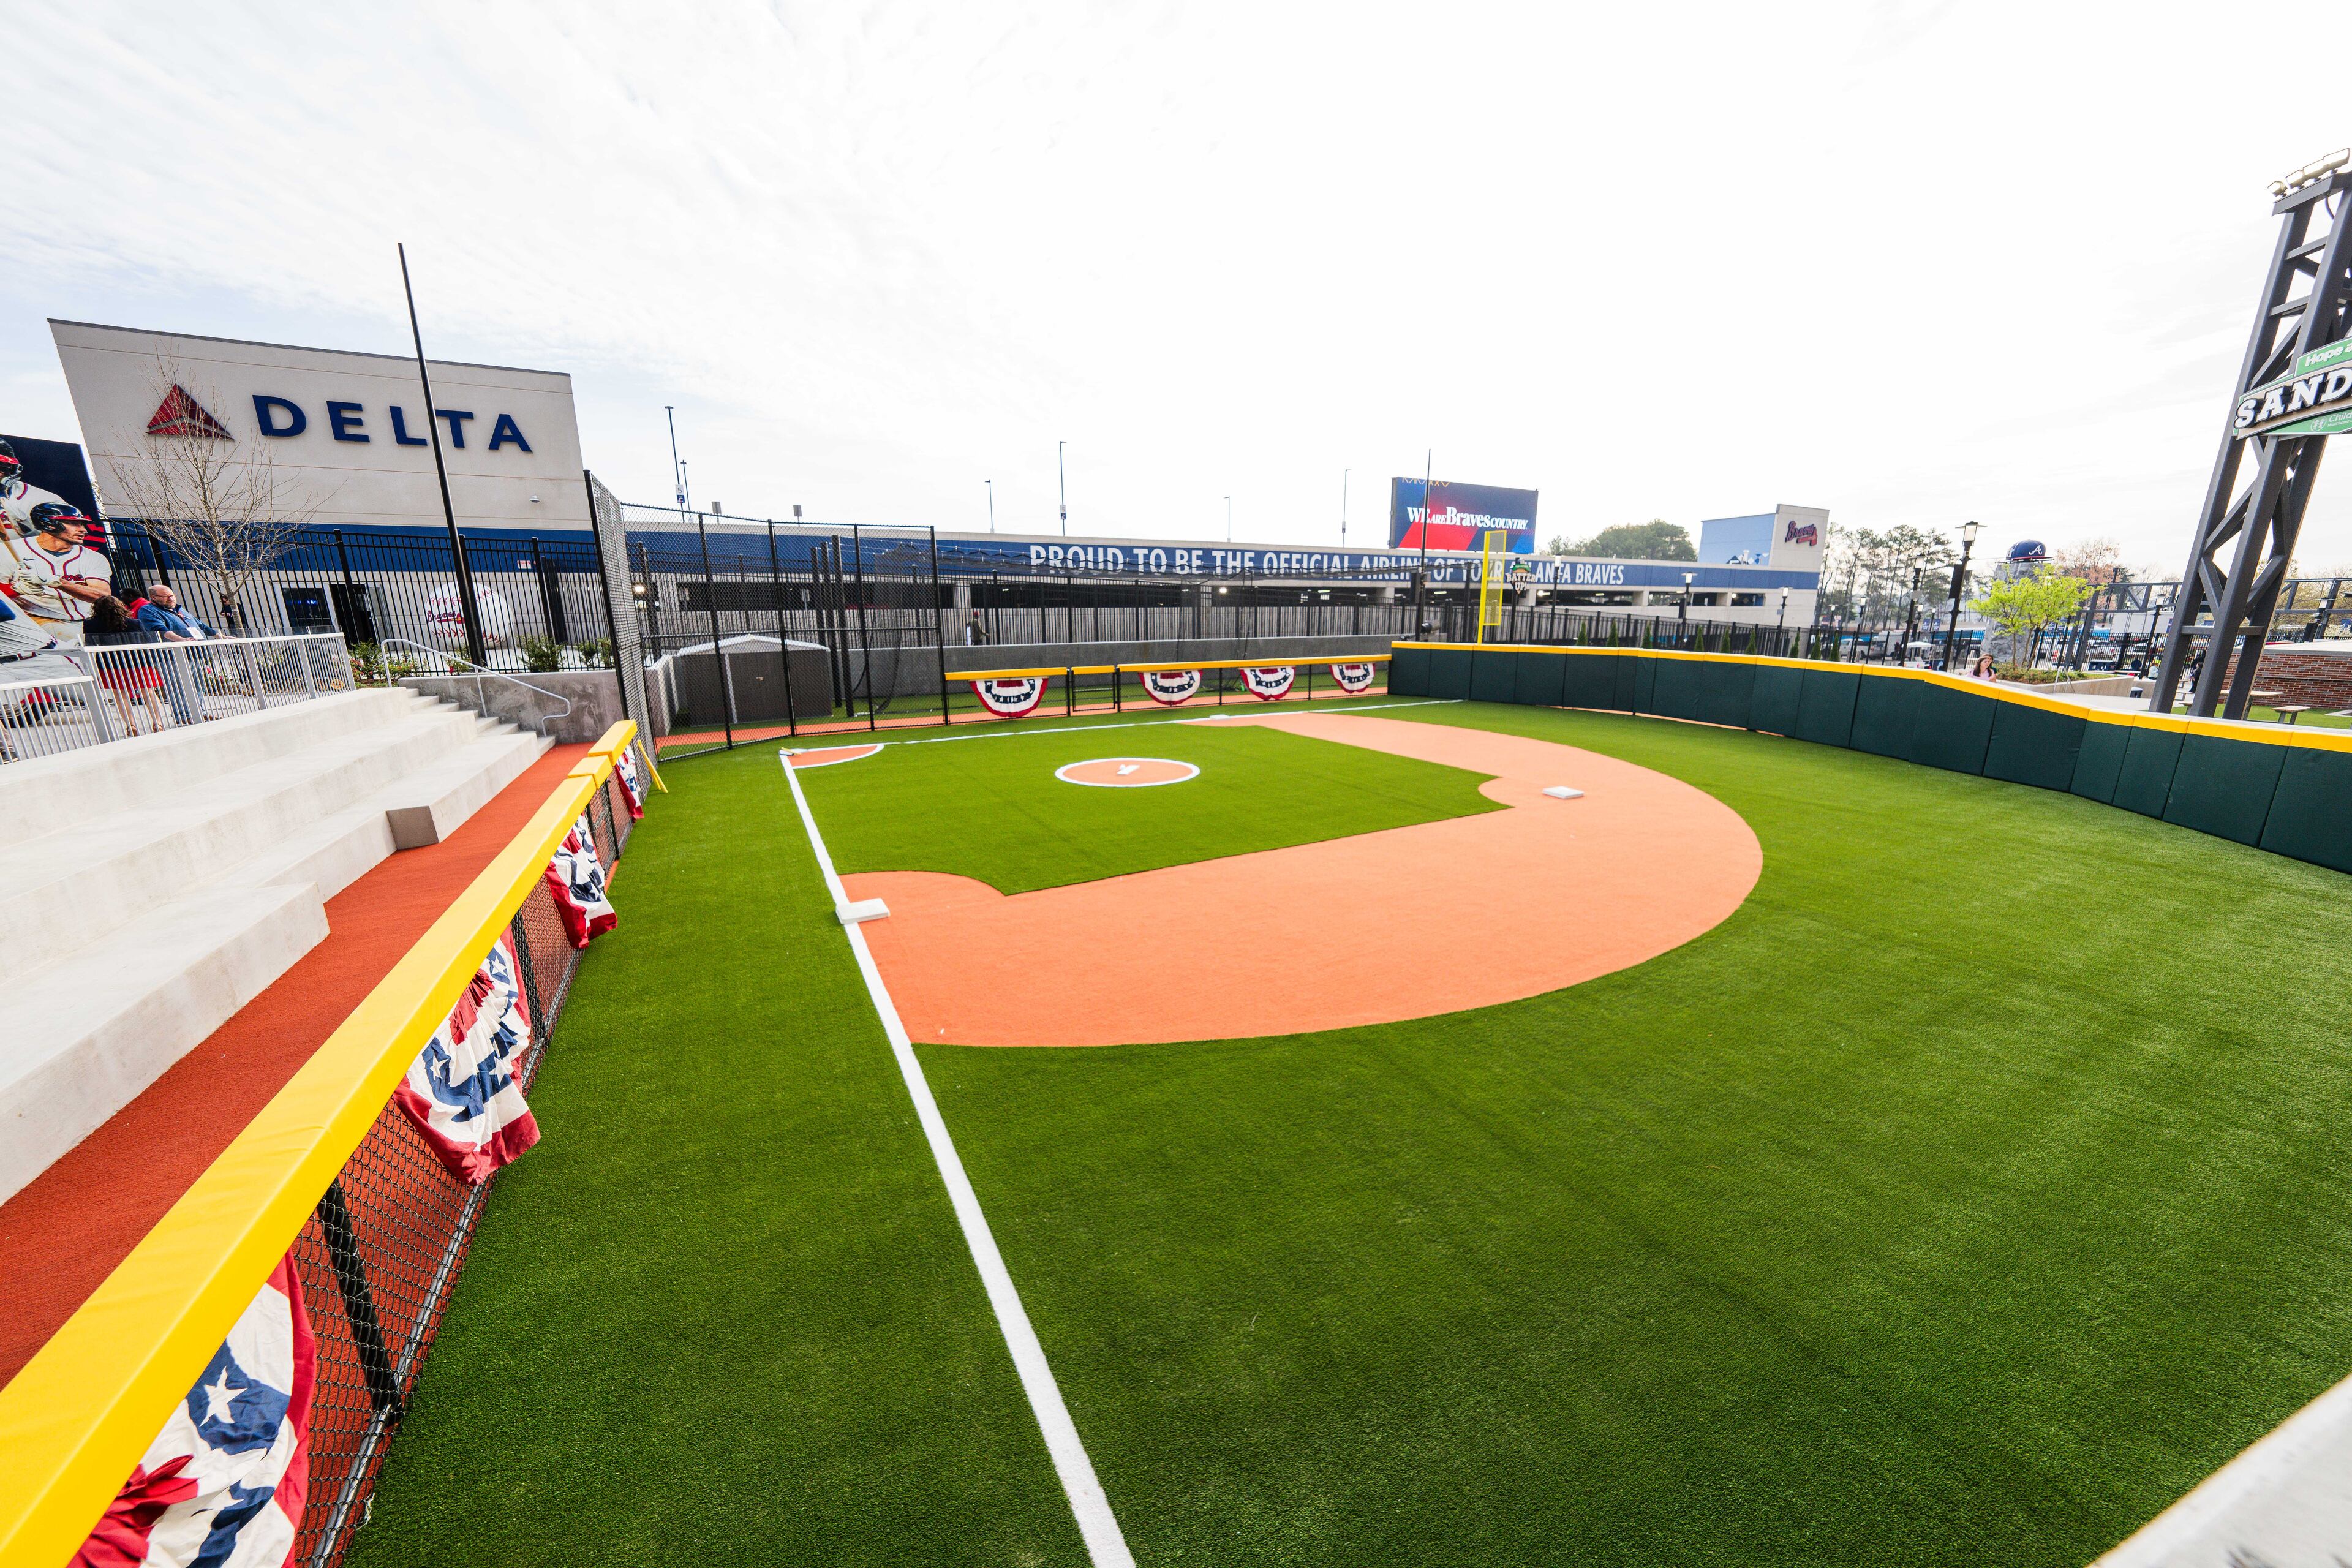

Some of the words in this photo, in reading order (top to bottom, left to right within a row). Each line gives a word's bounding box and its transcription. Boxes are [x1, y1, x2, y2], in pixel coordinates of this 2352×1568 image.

[2305, 346, 2343, 366] Hope
[2234, 368, 2352, 429] SAND
[252, 394, 533, 453] DELTA
[1430, 514, 1446, 524] ARE
[1446, 506, 1491, 528] Braves
[1030, 545, 1124, 574] PROUD
[1133, 548, 1167, 575] TO
[1175, 549, 1203, 575] BE
[1212, 550, 1255, 576] THE
[1263, 552, 1352, 579] OFFICIAL
[1433, 557, 1456, 581] OF
[1575, 564, 1624, 584] BRAVES
[1505, 572, 1536, 582] BATTER
[1515, 582, 1527, 591] UP!
[427, 610, 456, 623] Braves
